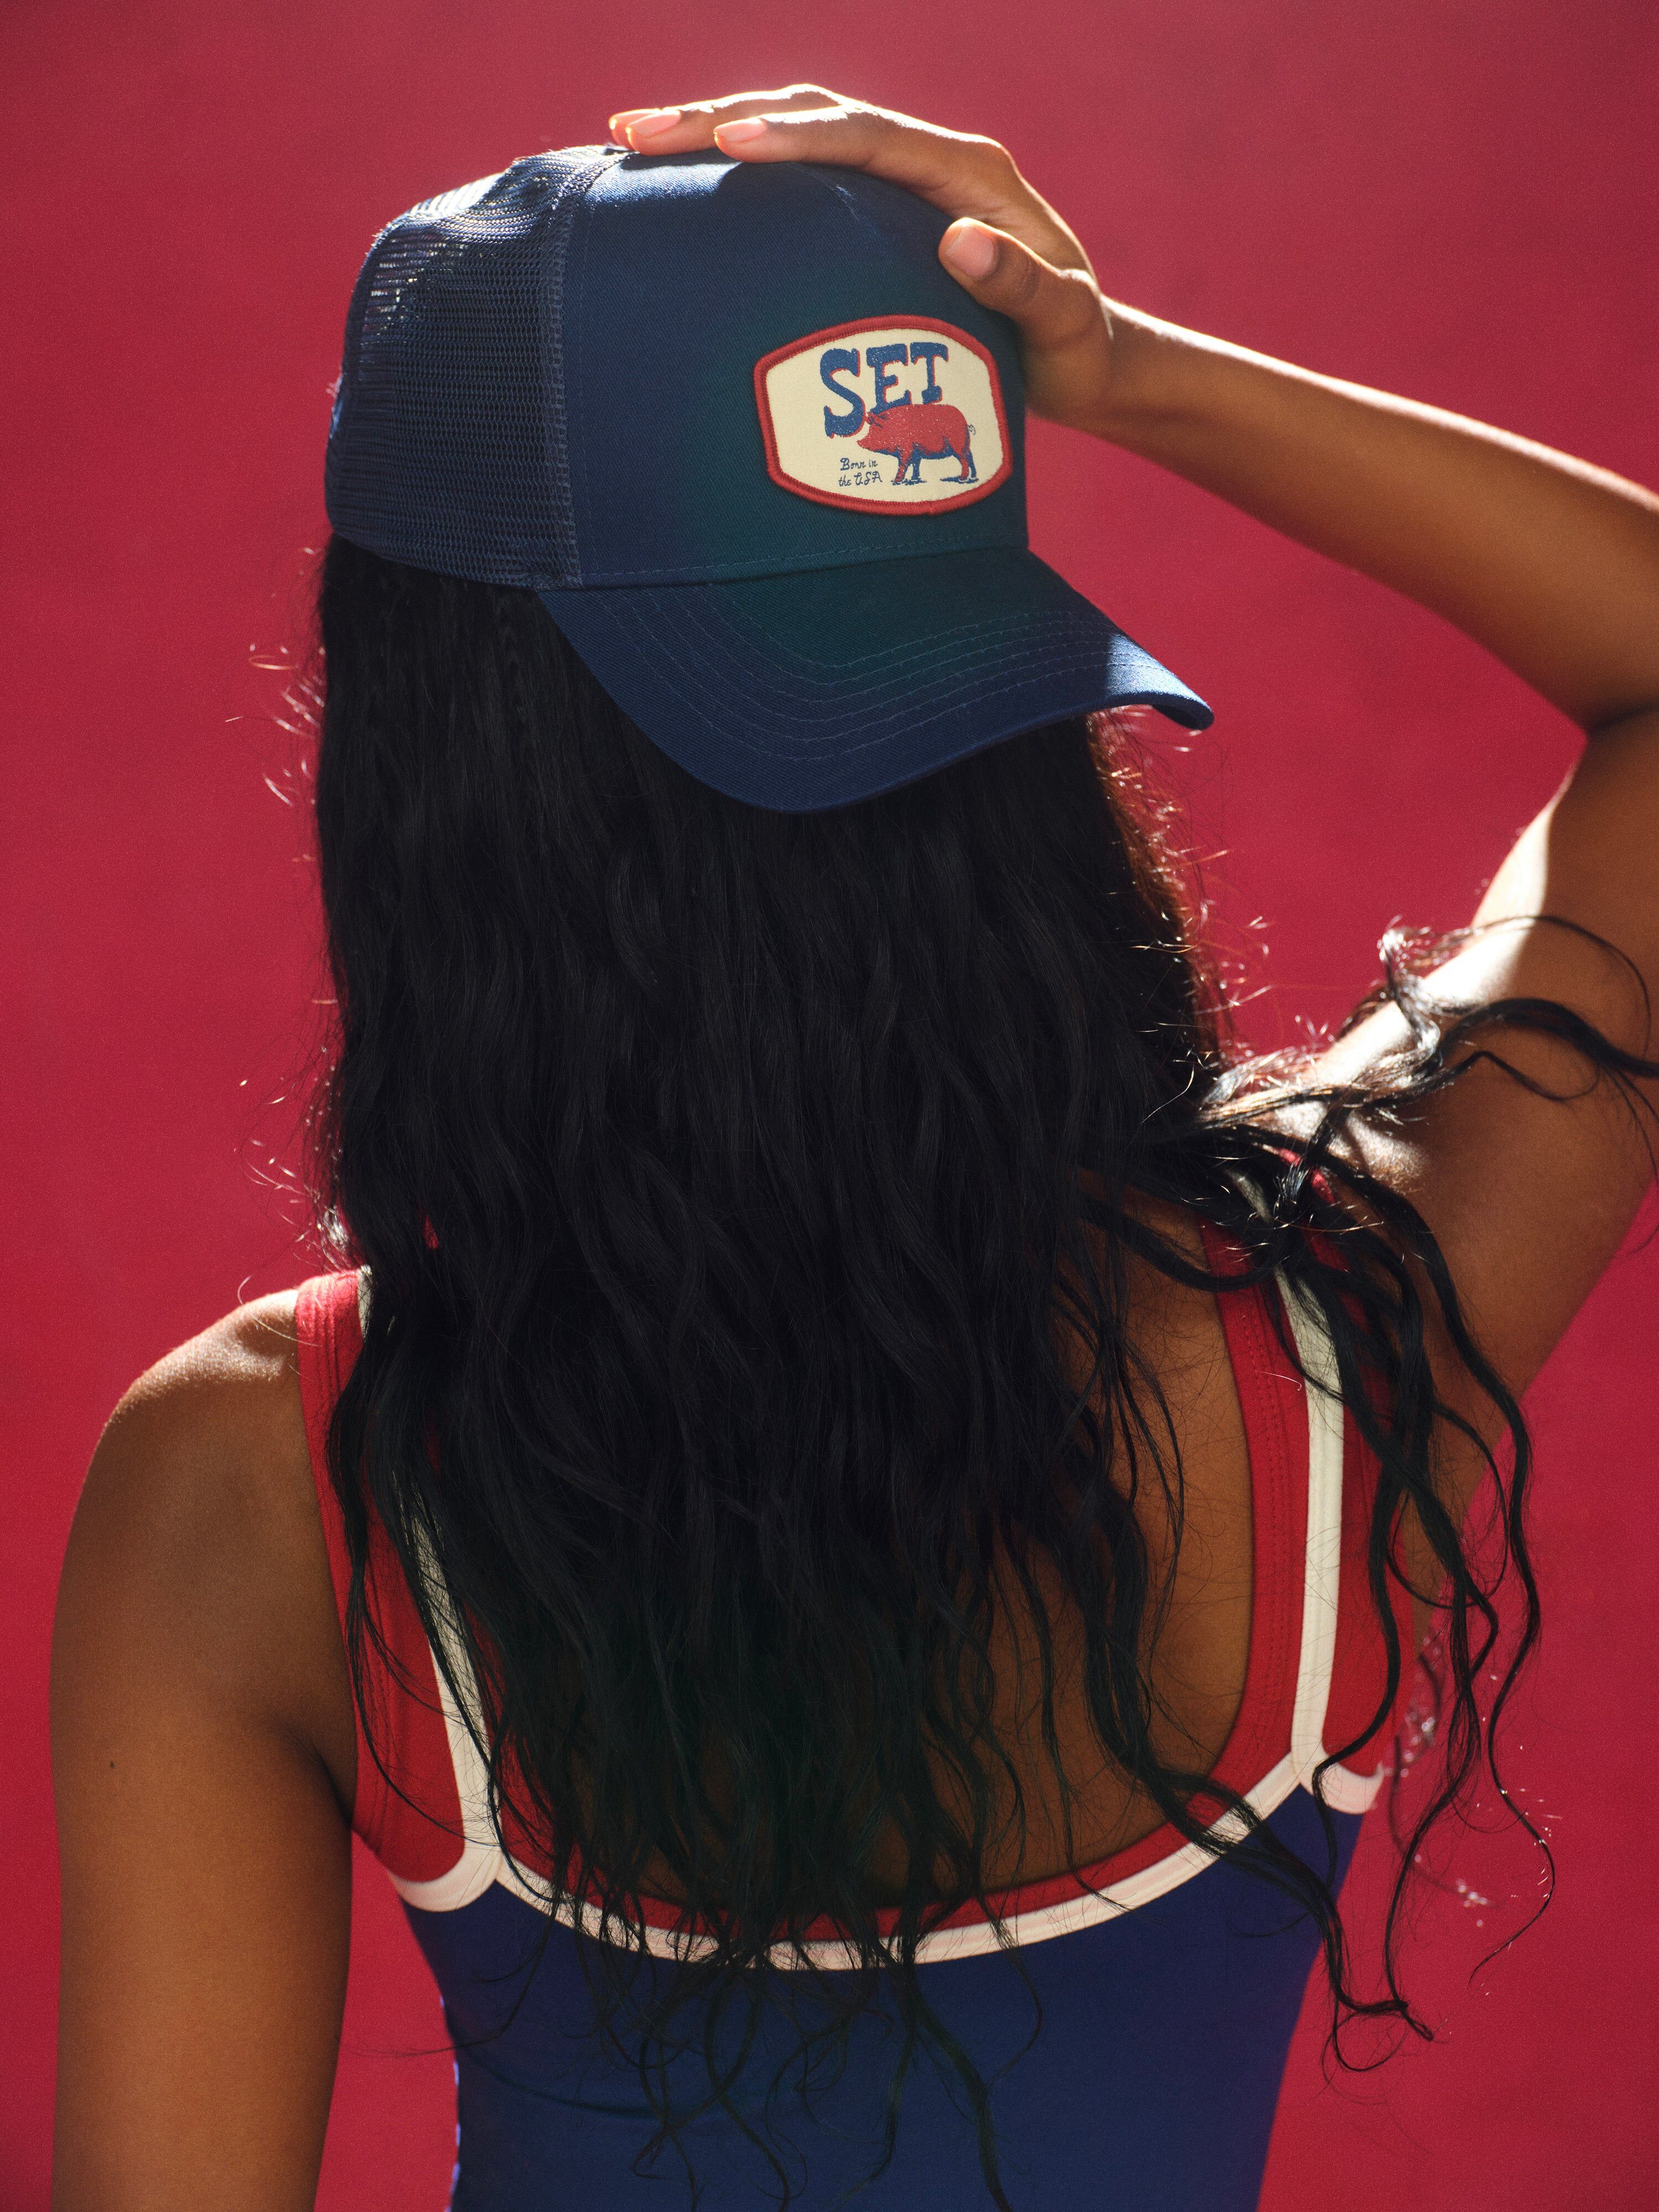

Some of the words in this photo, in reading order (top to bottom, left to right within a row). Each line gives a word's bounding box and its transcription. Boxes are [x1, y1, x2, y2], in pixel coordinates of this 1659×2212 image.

[820, 342, 948, 439] SET
[840, 458, 866, 471] Born
[869, 460, 878, 468] in
[838, 475, 852, 487] the
[854, 471, 883, 486] USA
